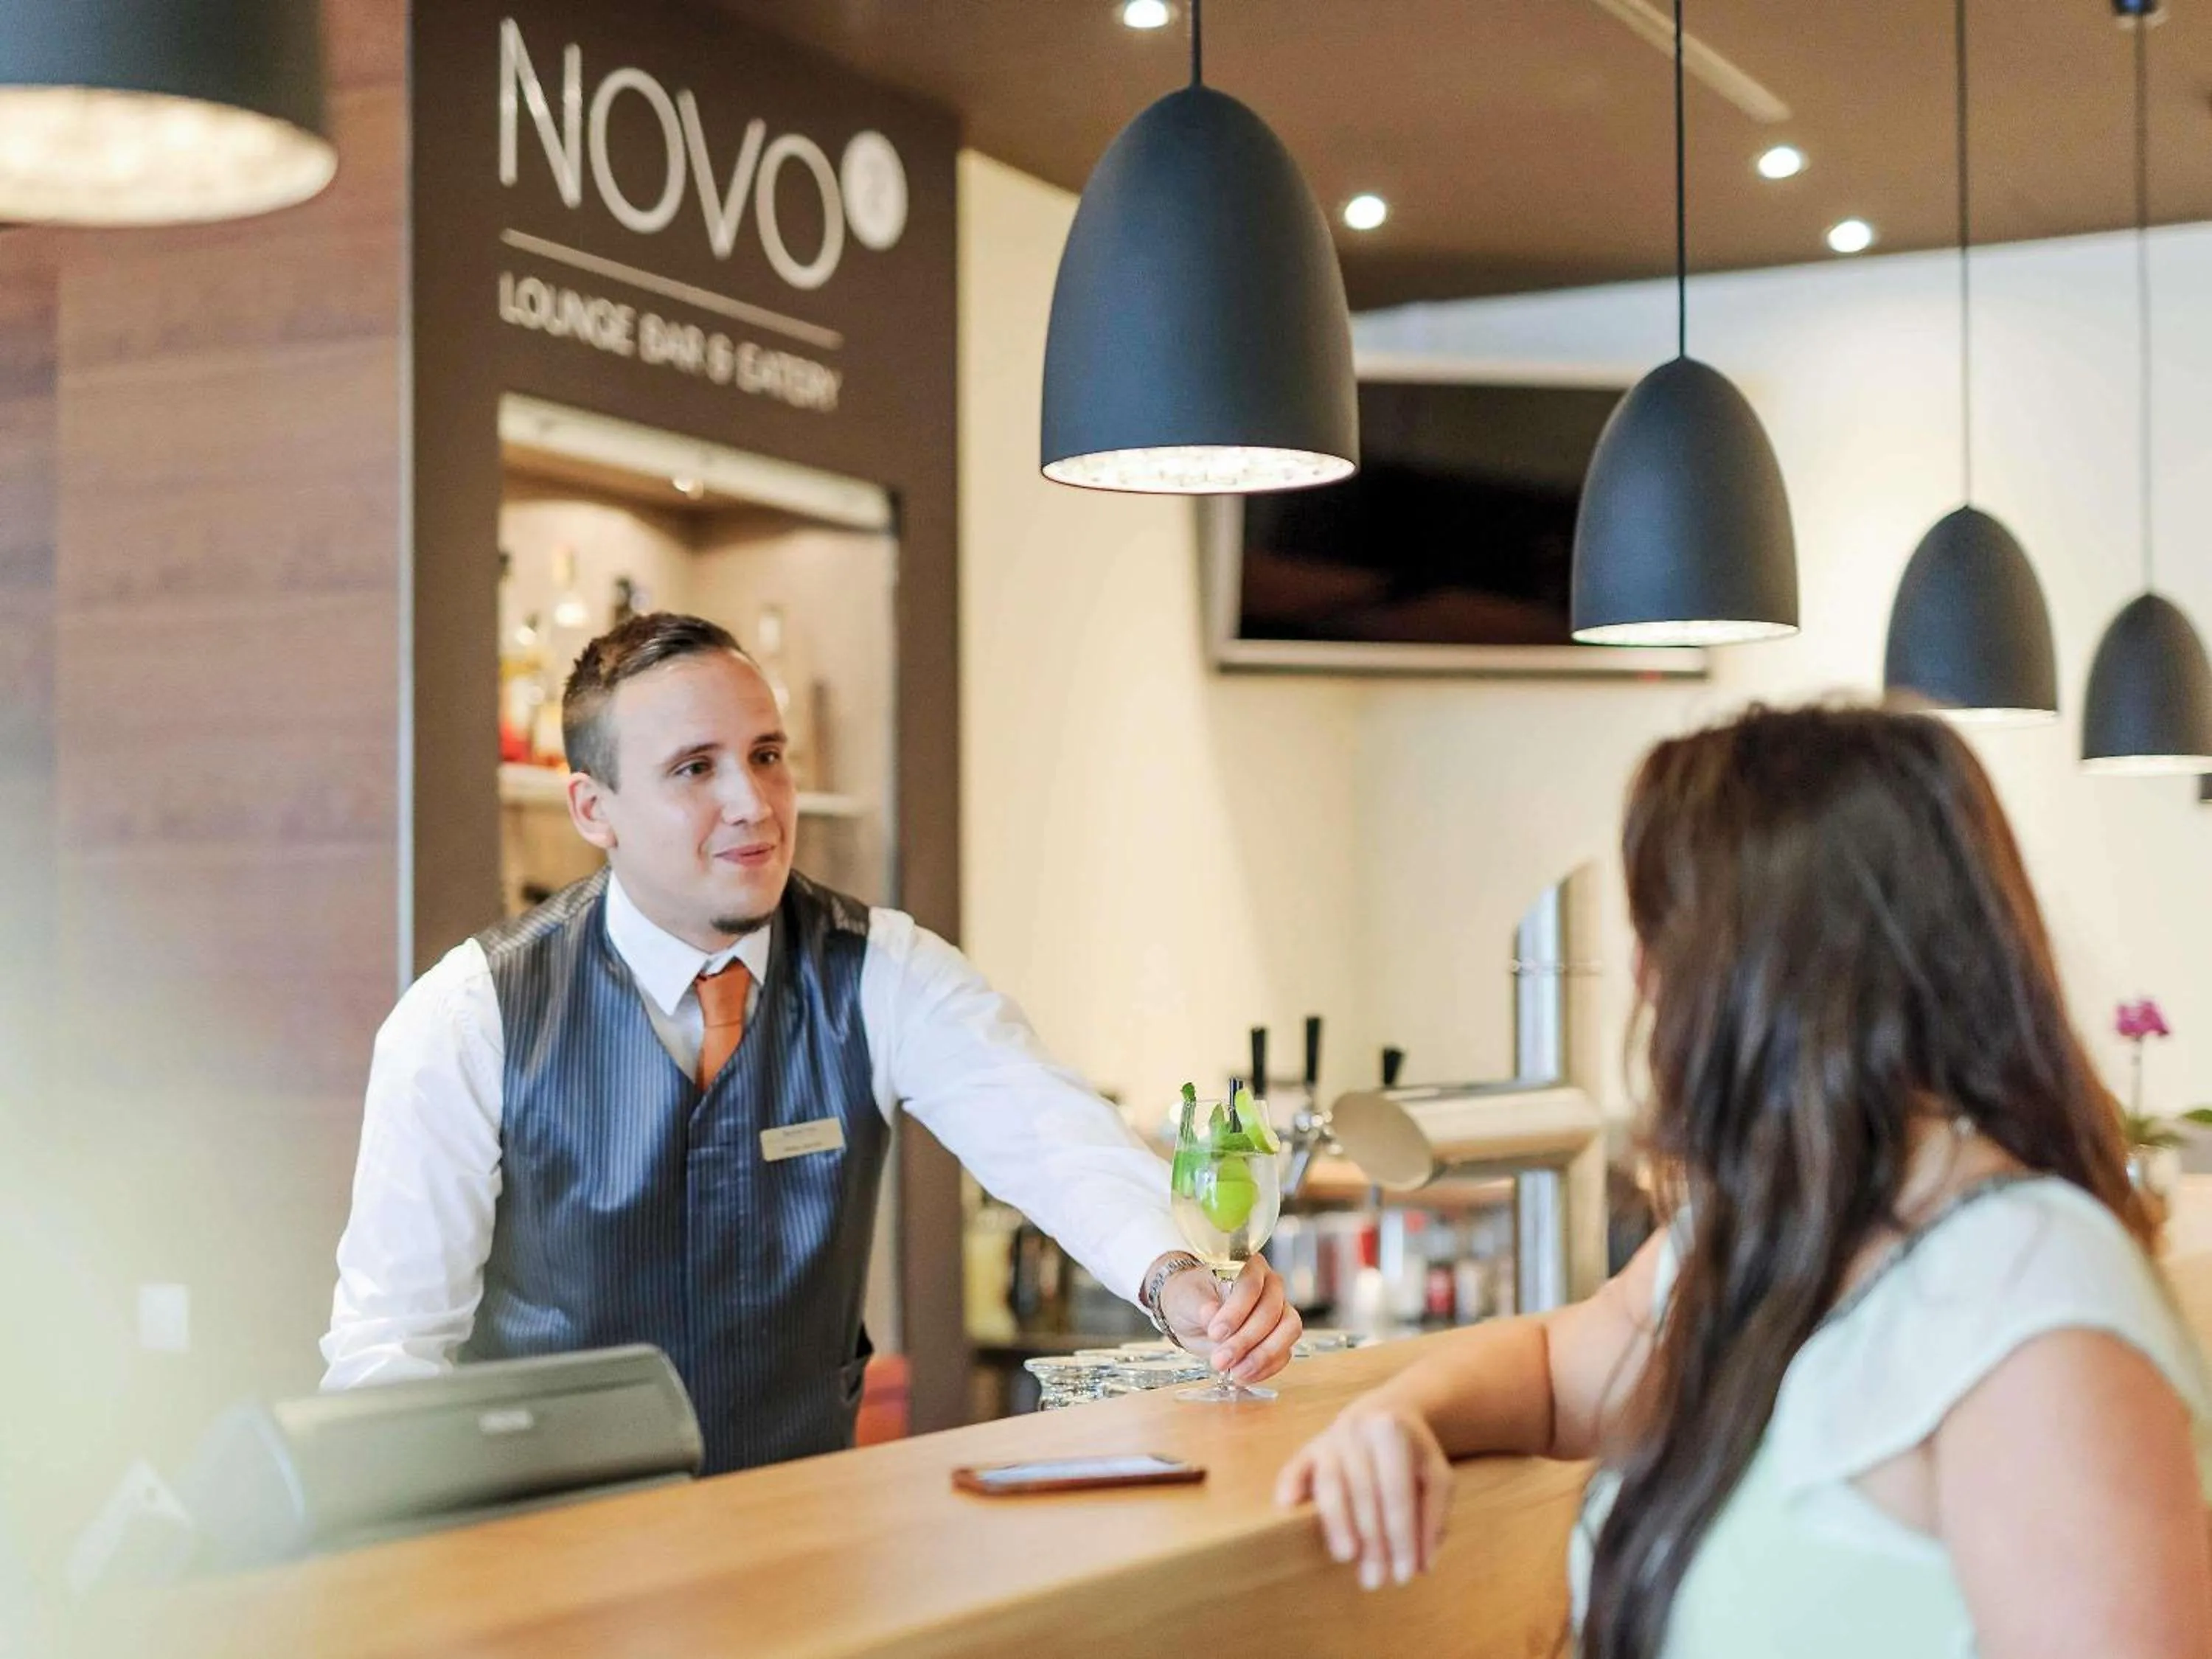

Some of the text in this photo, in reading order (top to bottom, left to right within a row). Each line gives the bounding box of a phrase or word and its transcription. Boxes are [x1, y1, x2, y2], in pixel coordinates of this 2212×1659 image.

[499, 17, 845, 290] NOVO
[499, 271, 636, 358] LOUNGE
[639, 313, 704, 375] BAR
[737, 342, 841, 412] EATERY
